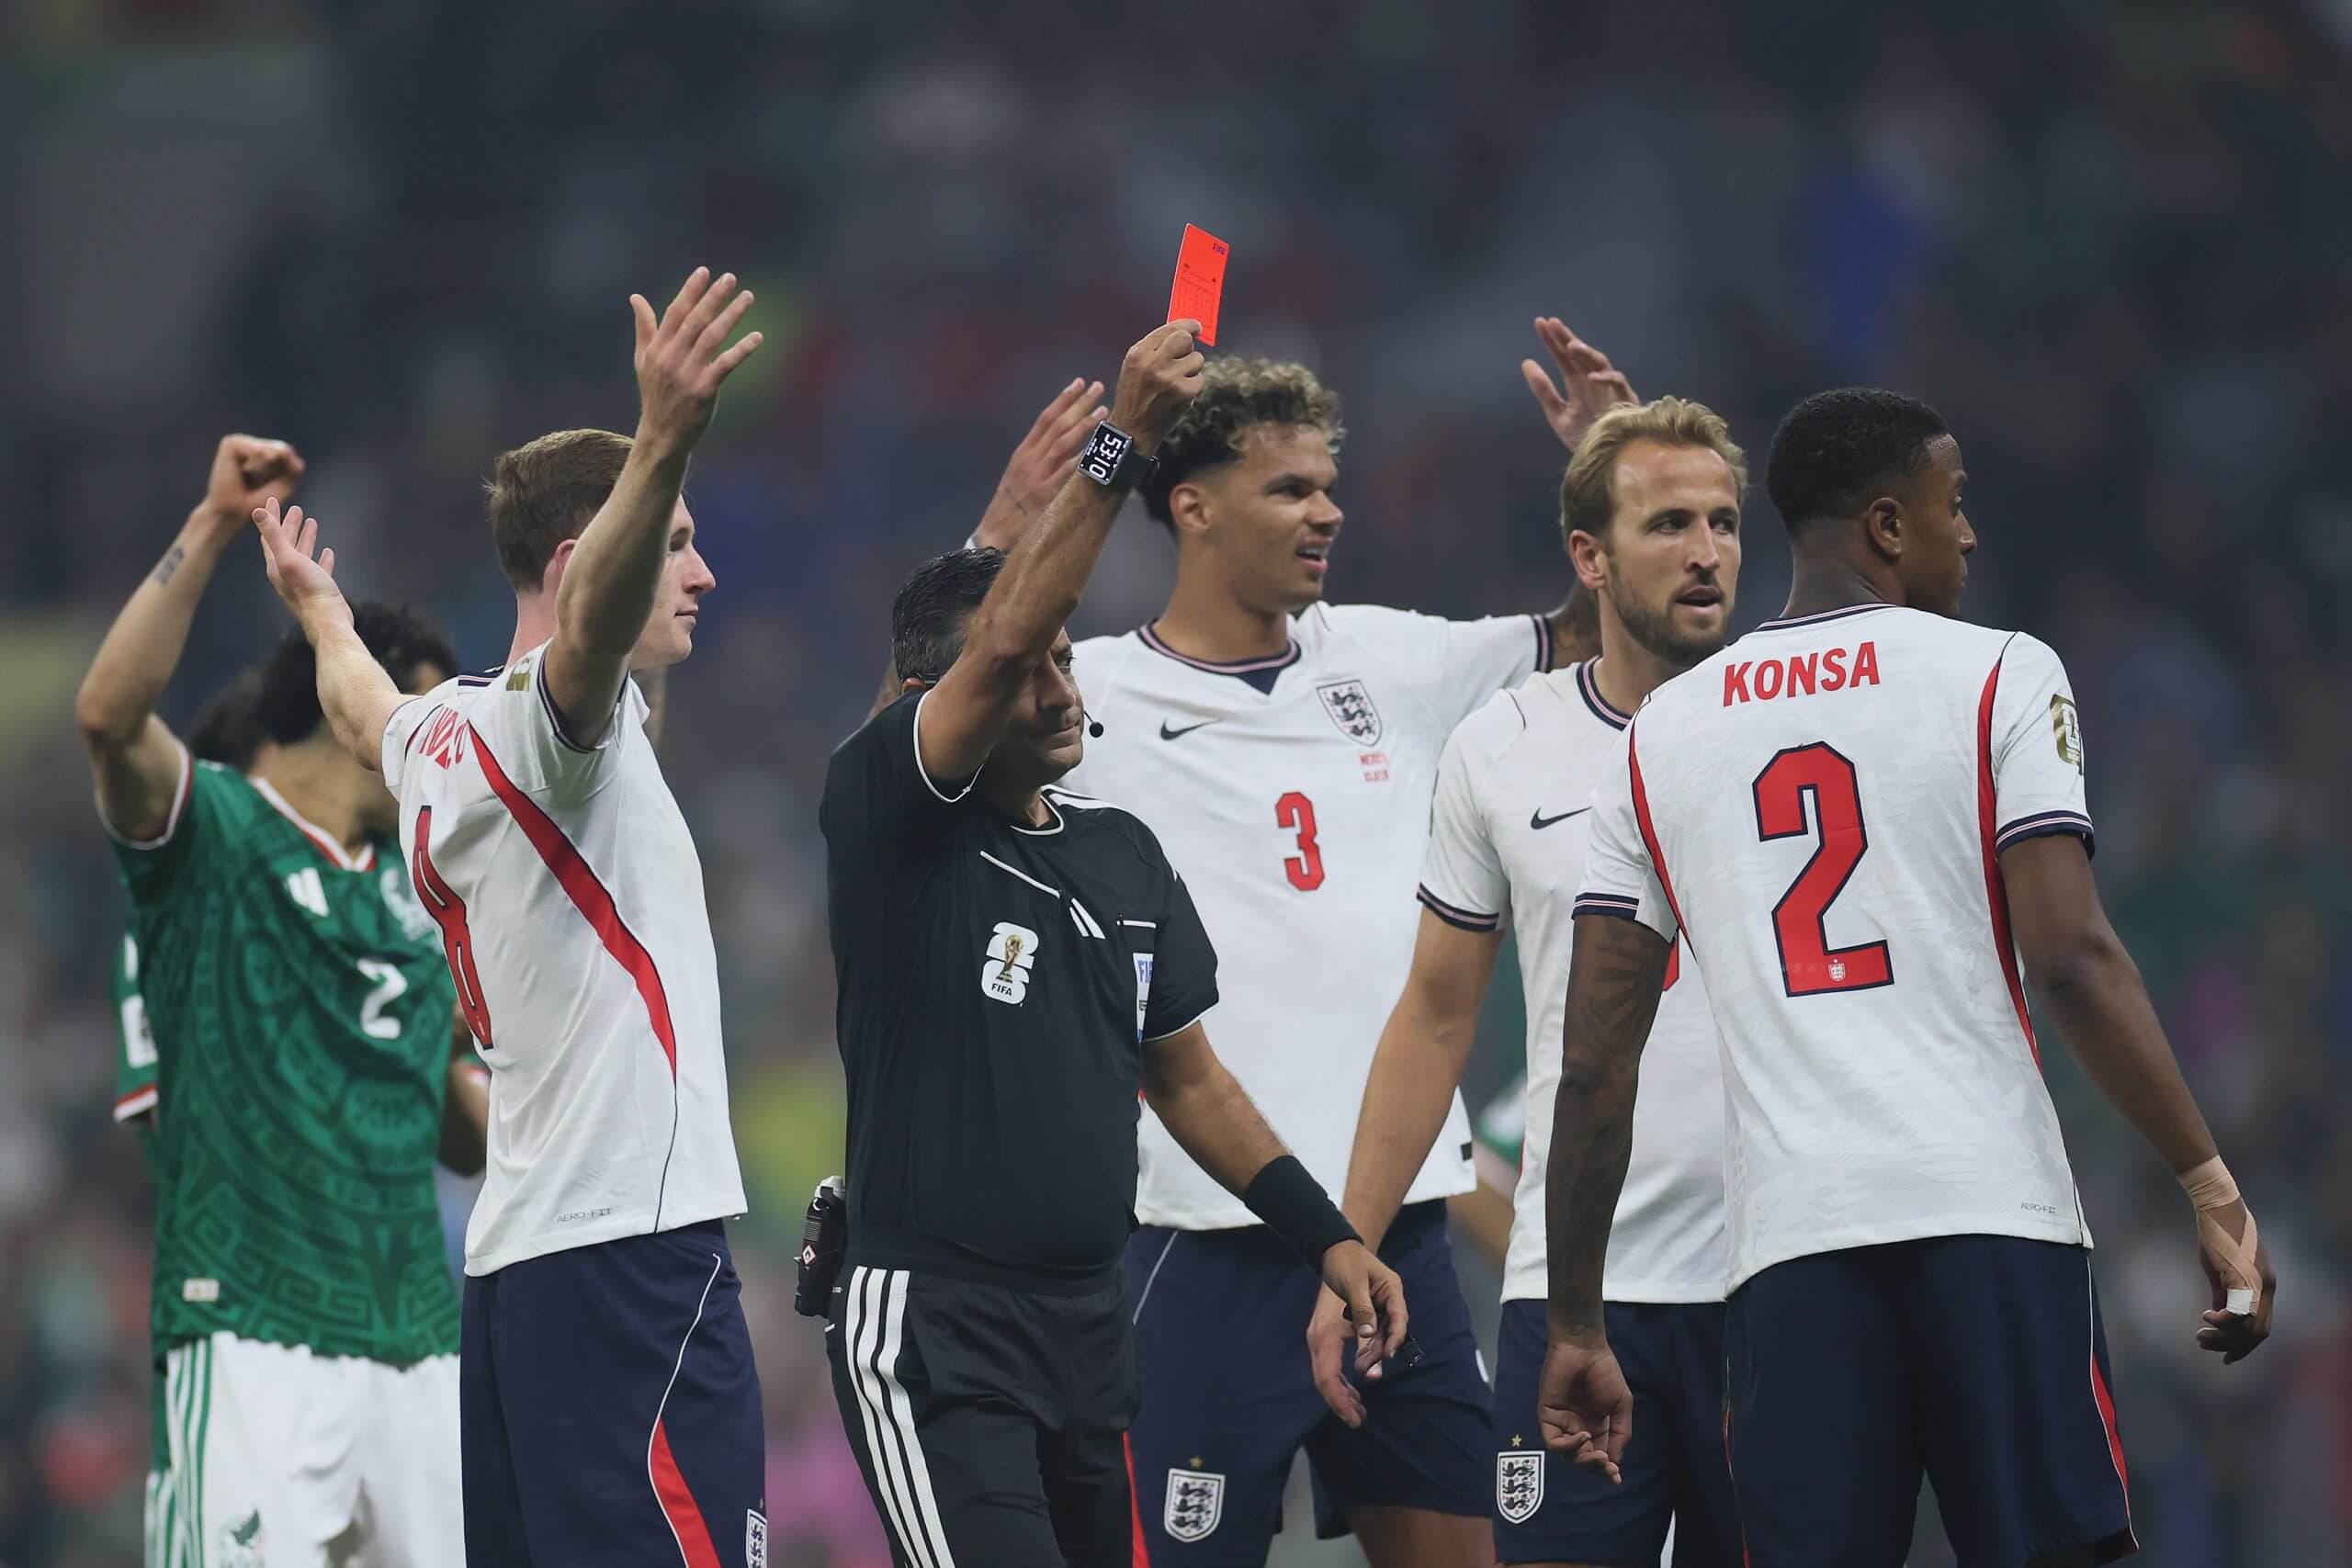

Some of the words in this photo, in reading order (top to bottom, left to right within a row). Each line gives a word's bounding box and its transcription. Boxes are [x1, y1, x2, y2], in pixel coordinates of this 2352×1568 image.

[1089, 433, 1123, 479] 53:10
[1723, 641, 1881, 707] KONSA
[1275, 791, 1325, 892] 3
[1752, 740, 1895, 998] 2
[413, 805, 494, 1051] 8
[356, 957, 408, 1039] 2
[991, 983, 1012, 997] FIFA
